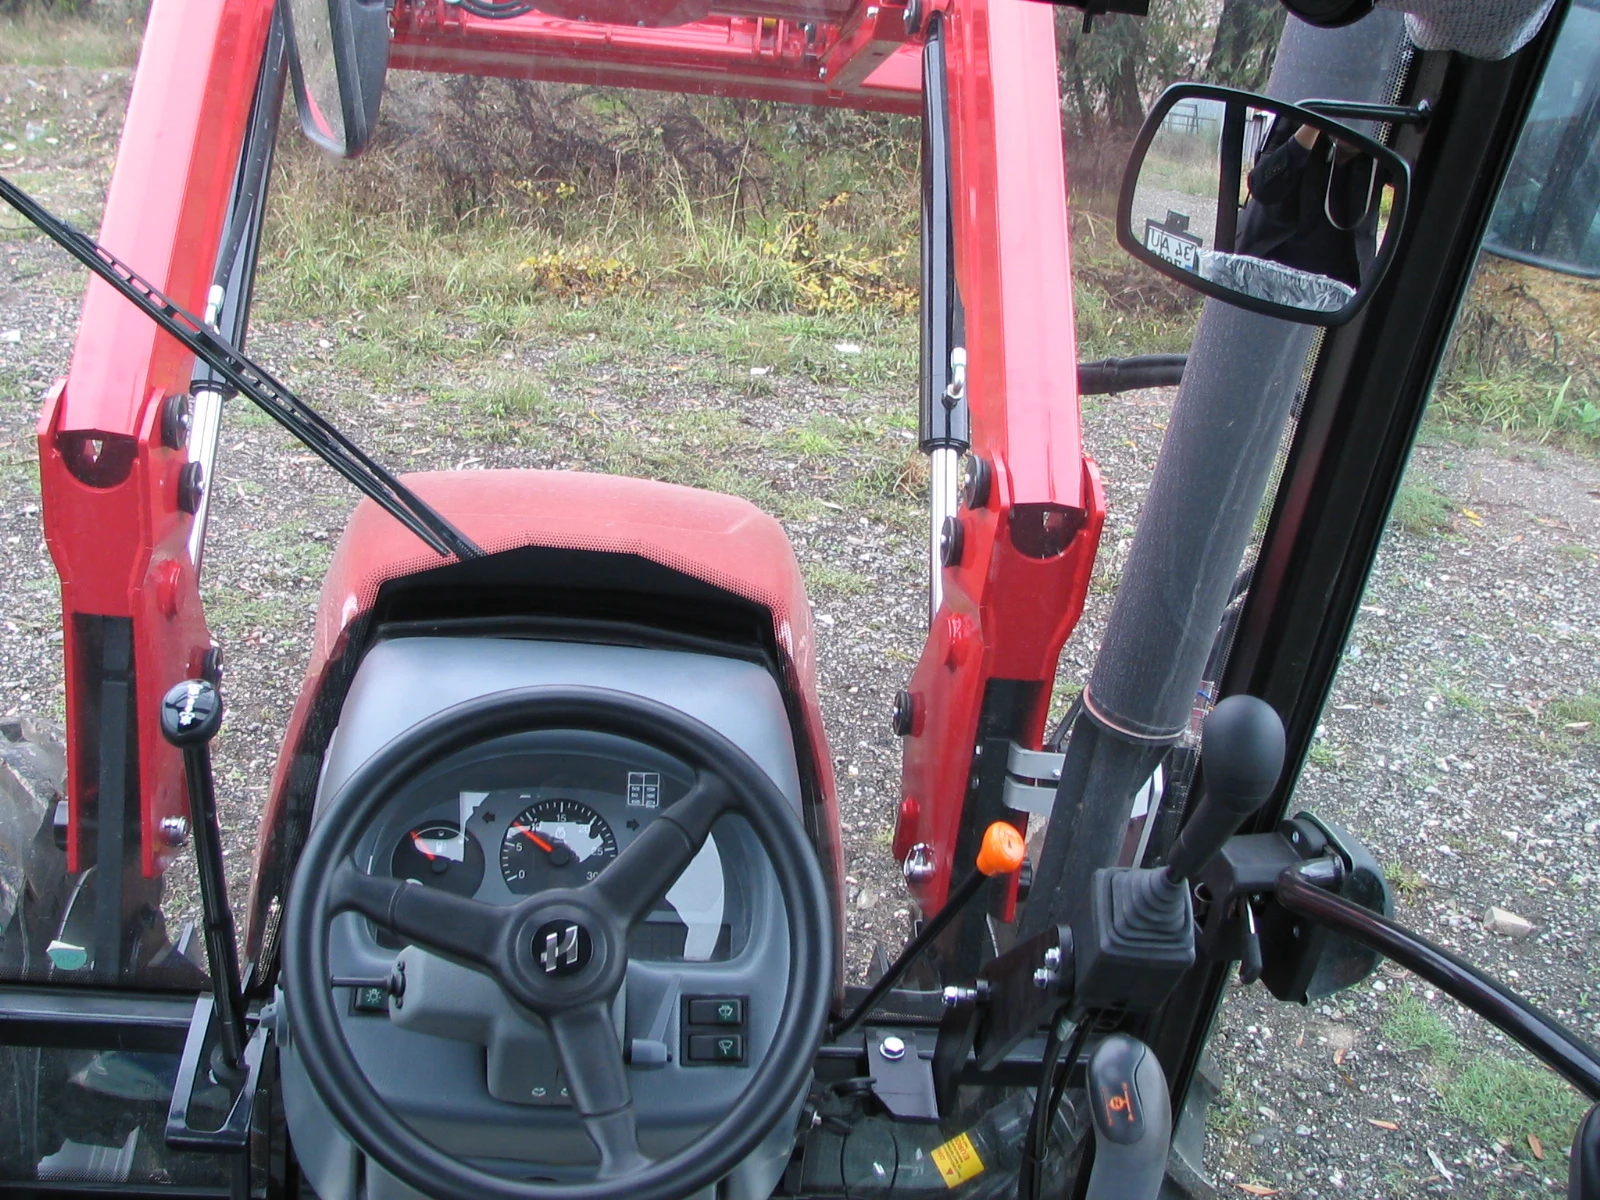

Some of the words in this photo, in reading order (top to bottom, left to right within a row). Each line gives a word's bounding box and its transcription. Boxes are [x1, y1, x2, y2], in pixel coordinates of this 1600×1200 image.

[556, 814, 567, 822] 15
[578, 824, 590, 833] 20
[516, 843, 523, 852] 5
[591, 847, 603, 856] 25
[518, 869, 526, 879] 0
[586, 871, 599, 880] 30
